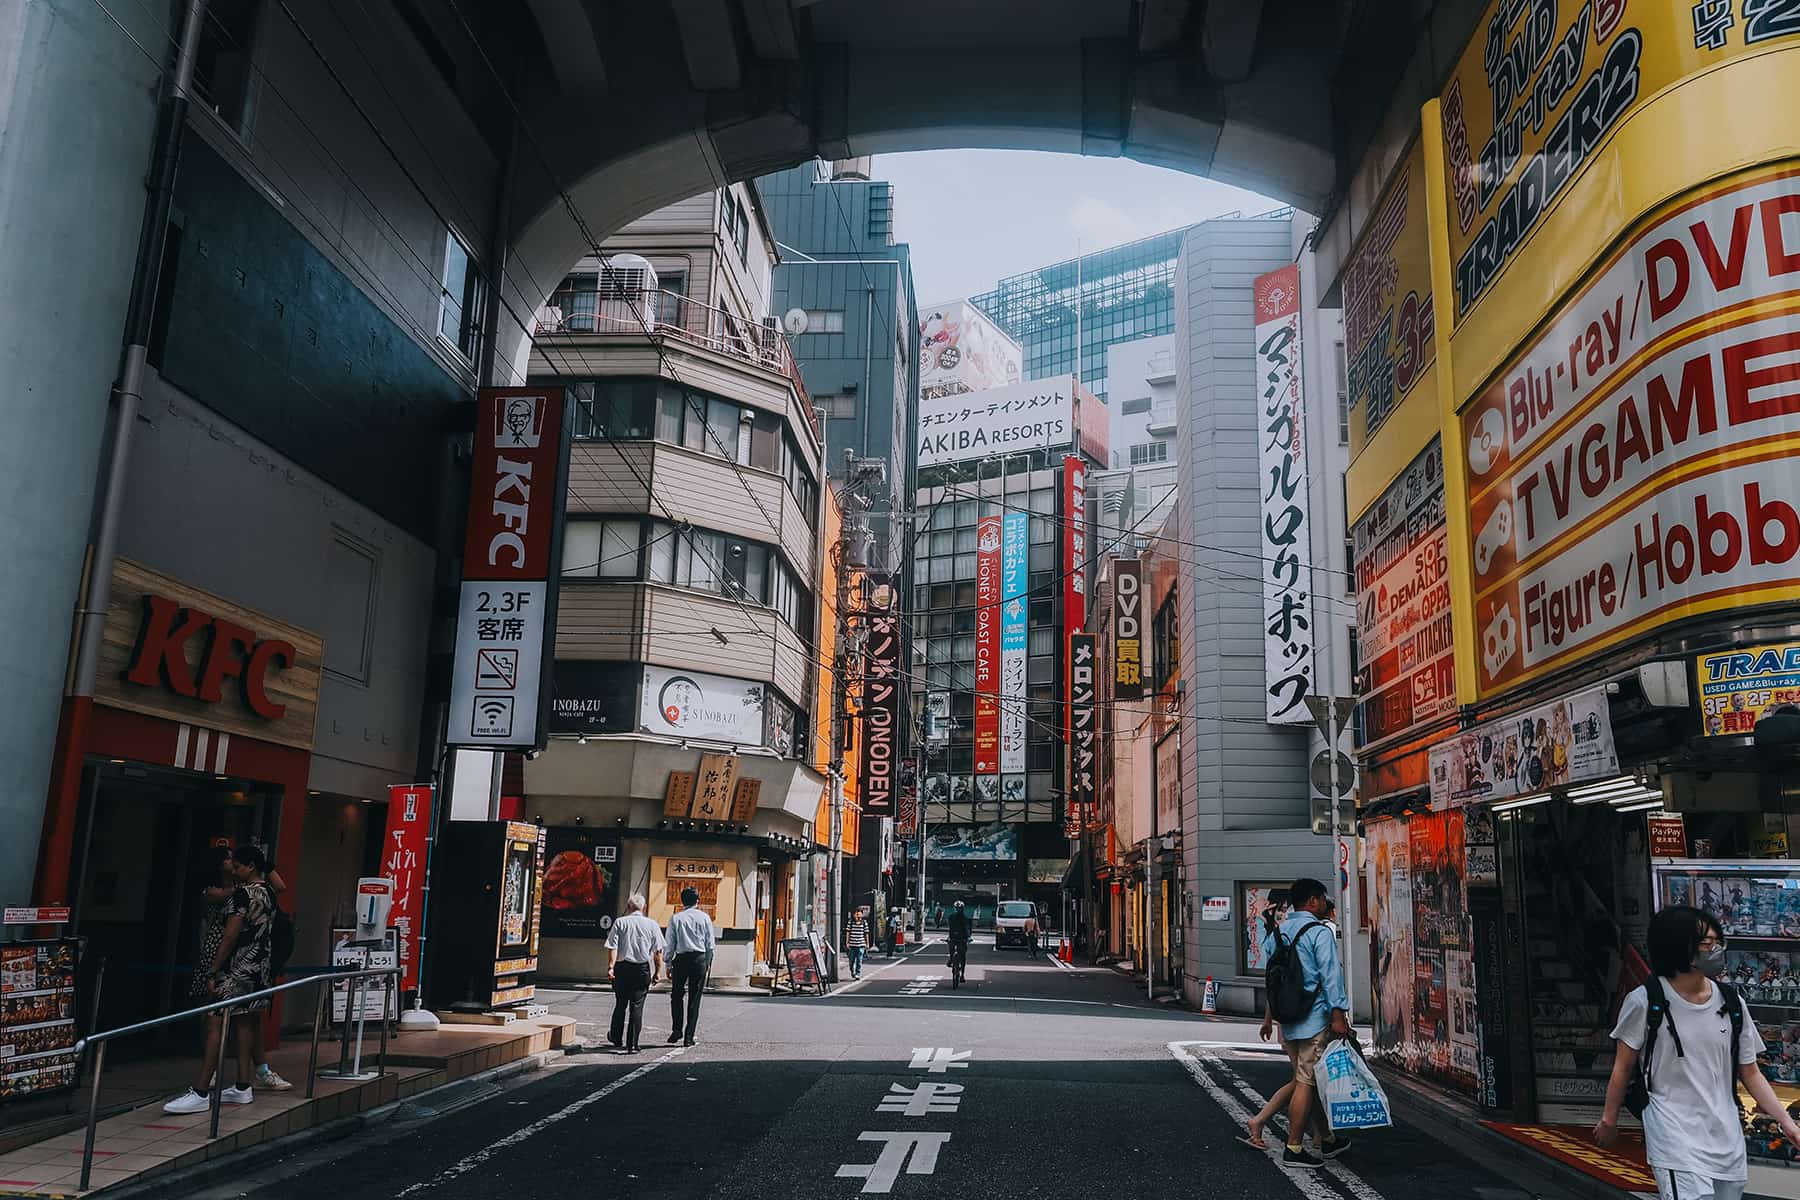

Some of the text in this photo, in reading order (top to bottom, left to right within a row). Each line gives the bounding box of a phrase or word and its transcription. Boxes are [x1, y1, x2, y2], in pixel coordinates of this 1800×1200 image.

[1493, 0, 1557, 132] DVD
[1480, 2, 1591, 213] Blu-ray
[1457, 29, 1641, 316] TRADER2
[918, 419, 1063, 456] AKIBA RESORTS
[1516, 330, 1800, 542] TVGAME
[488, 455, 533, 569] KFC
[1005, 519, 1017, 593] コラボカフェ
[979, 558, 990, 601] HONEY
[1391, 559, 1447, 609] DEMAND
[475, 591, 531, 615] 2,3F
[978, 604, 990, 644] TOAST
[476, 618, 526, 642] 客席
[128, 594, 297, 720] KFC
[977, 648, 989, 681] CAFE
[552, 699, 601, 712] INOBAZU
[1704, 696, 1728, 717] 3F
[1747, 691, 1772, 706] 2F
[1705, 683, 1727, 694] USED
[1072, 644, 1096, 792] メロンブックス
[868, 706, 892, 807] ONODEN
[1651, 827, 1681, 838] PayPay
